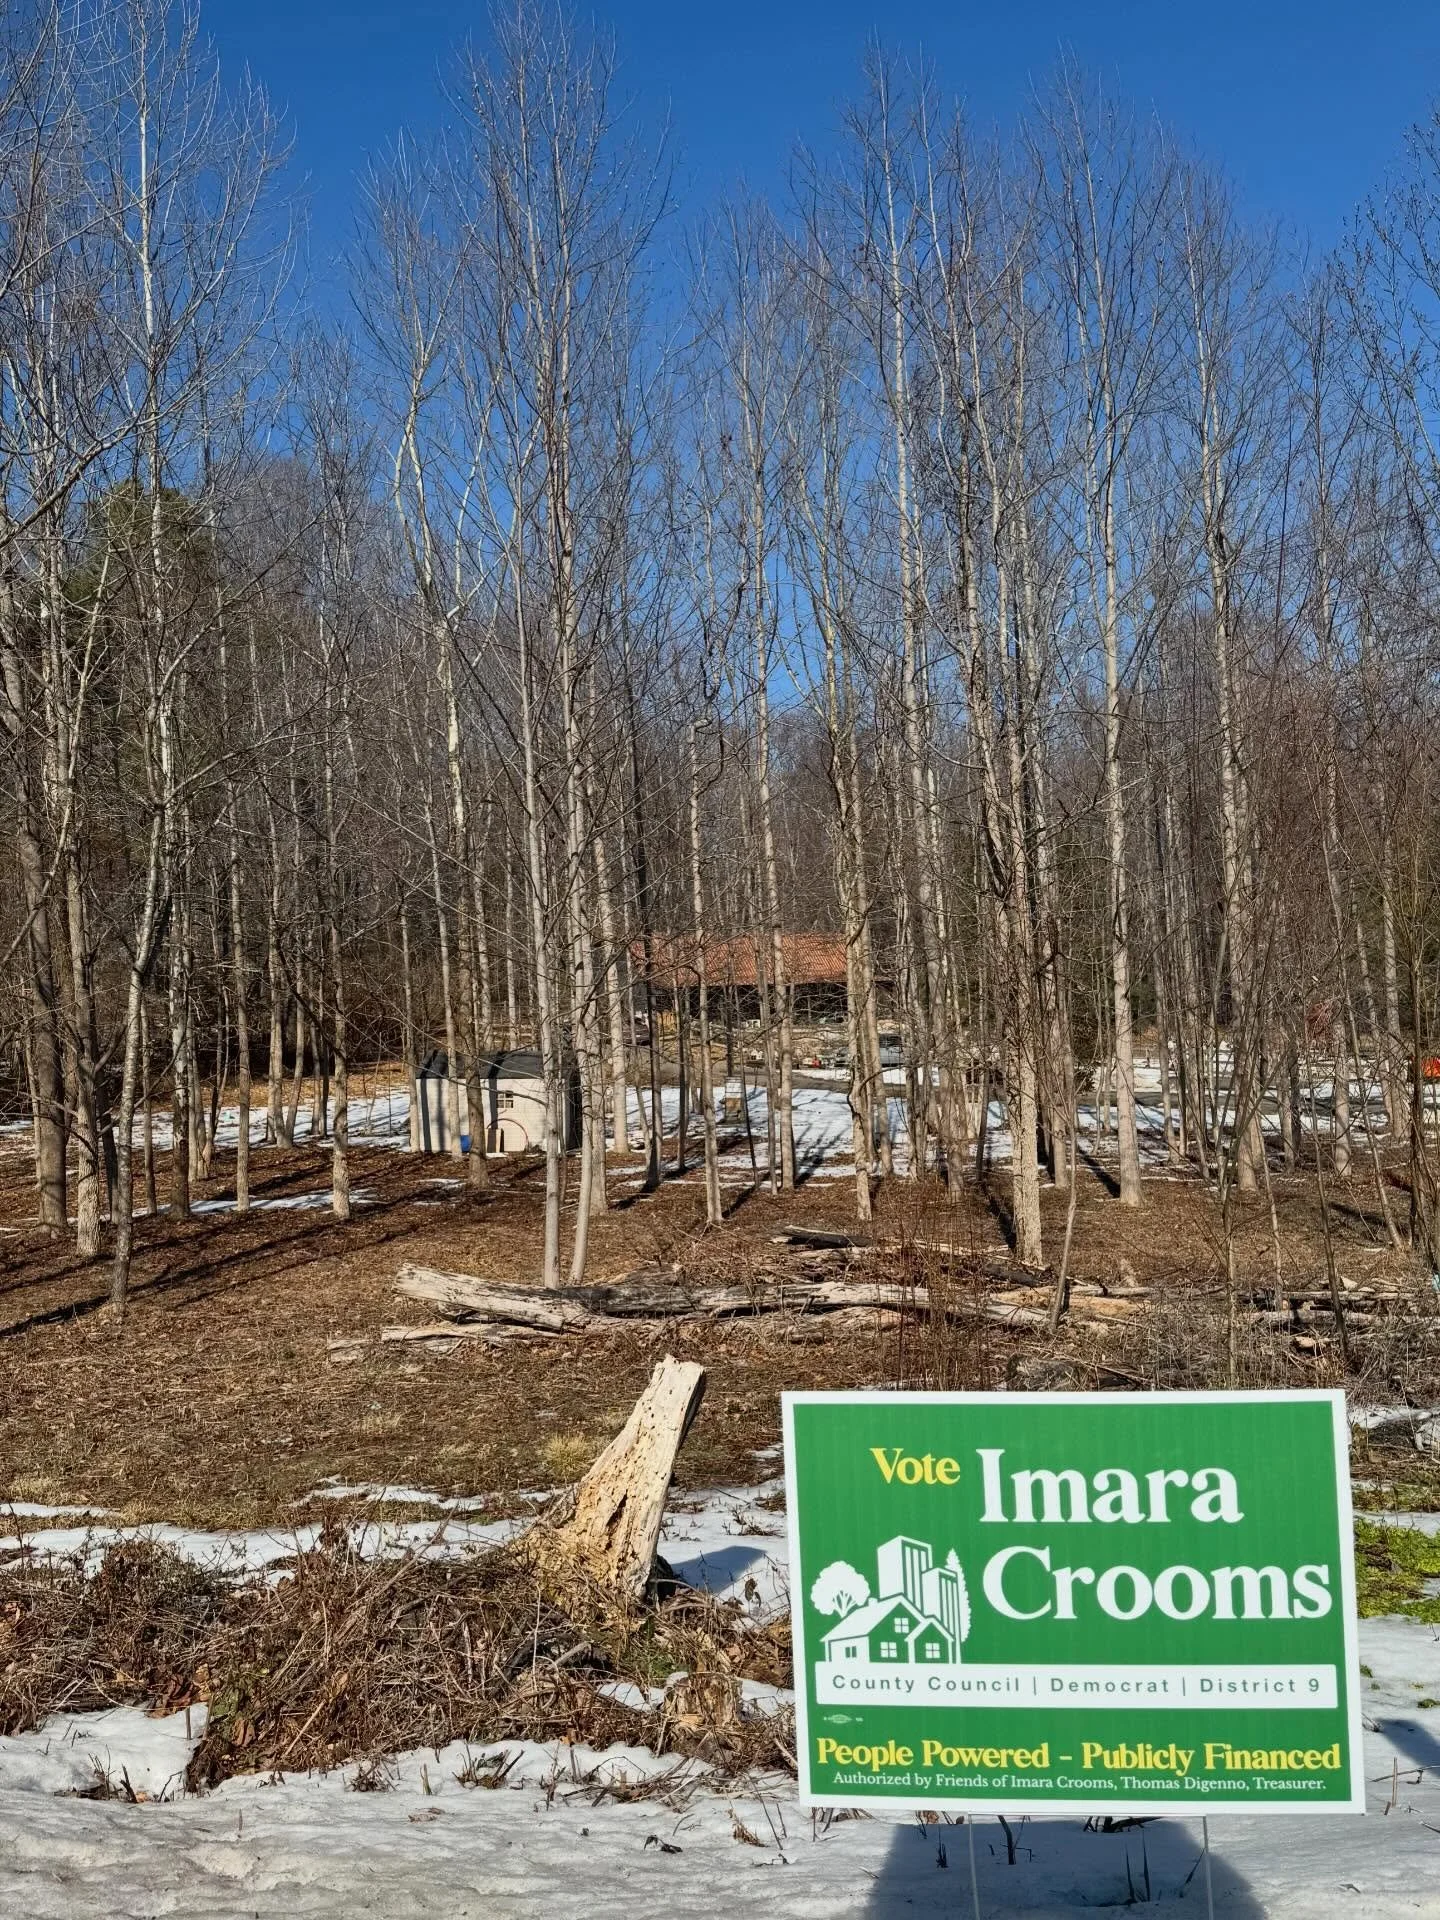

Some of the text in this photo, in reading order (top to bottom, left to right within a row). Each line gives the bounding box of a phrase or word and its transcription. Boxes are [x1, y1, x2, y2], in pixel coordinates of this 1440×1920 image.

[869, 1447, 1245, 1524] Vote Imara
[982, 1545, 1333, 1620] Crooms
[832, 1674, 915, 1693] County
[928, 1676, 1020, 1692] Council
[1050, 1677, 1170, 1693] Democrat
[1200, 1677, 1297, 1693] District
[1308, 1677, 1321, 1693] 9
[816, 1737, 914, 1772] People
[921, 1739, 1051, 1769] Powered
[1081, 1741, 1196, 1777] Publicly
[1203, 1742, 1343, 1770] Financed
[832, 1771, 1327, 1793] Authorized by Friends of Imara Crooms, Thomas Digenno, Treasurer.
